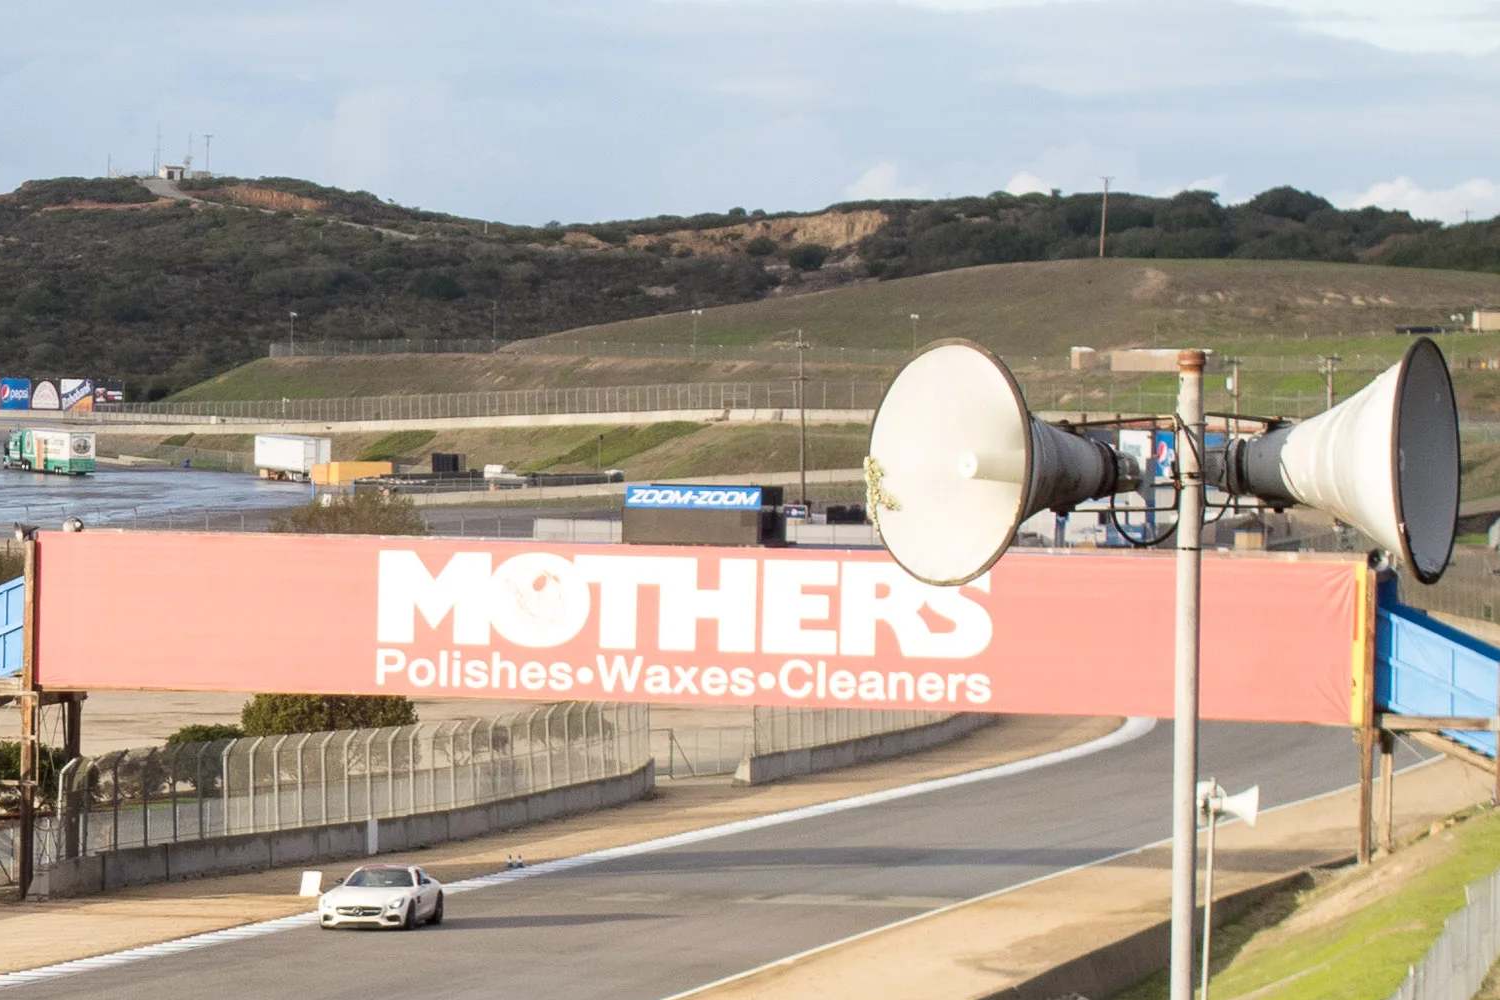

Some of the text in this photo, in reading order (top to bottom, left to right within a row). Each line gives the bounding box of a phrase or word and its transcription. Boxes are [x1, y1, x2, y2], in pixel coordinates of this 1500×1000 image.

[10, 387, 29, 400] pepsi
[627, 488, 760, 506] ZOOM-ZOOM
[376, 549, 994, 660] MOTHERS
[375, 648, 992, 704] Polishes Waxes Cleaners
